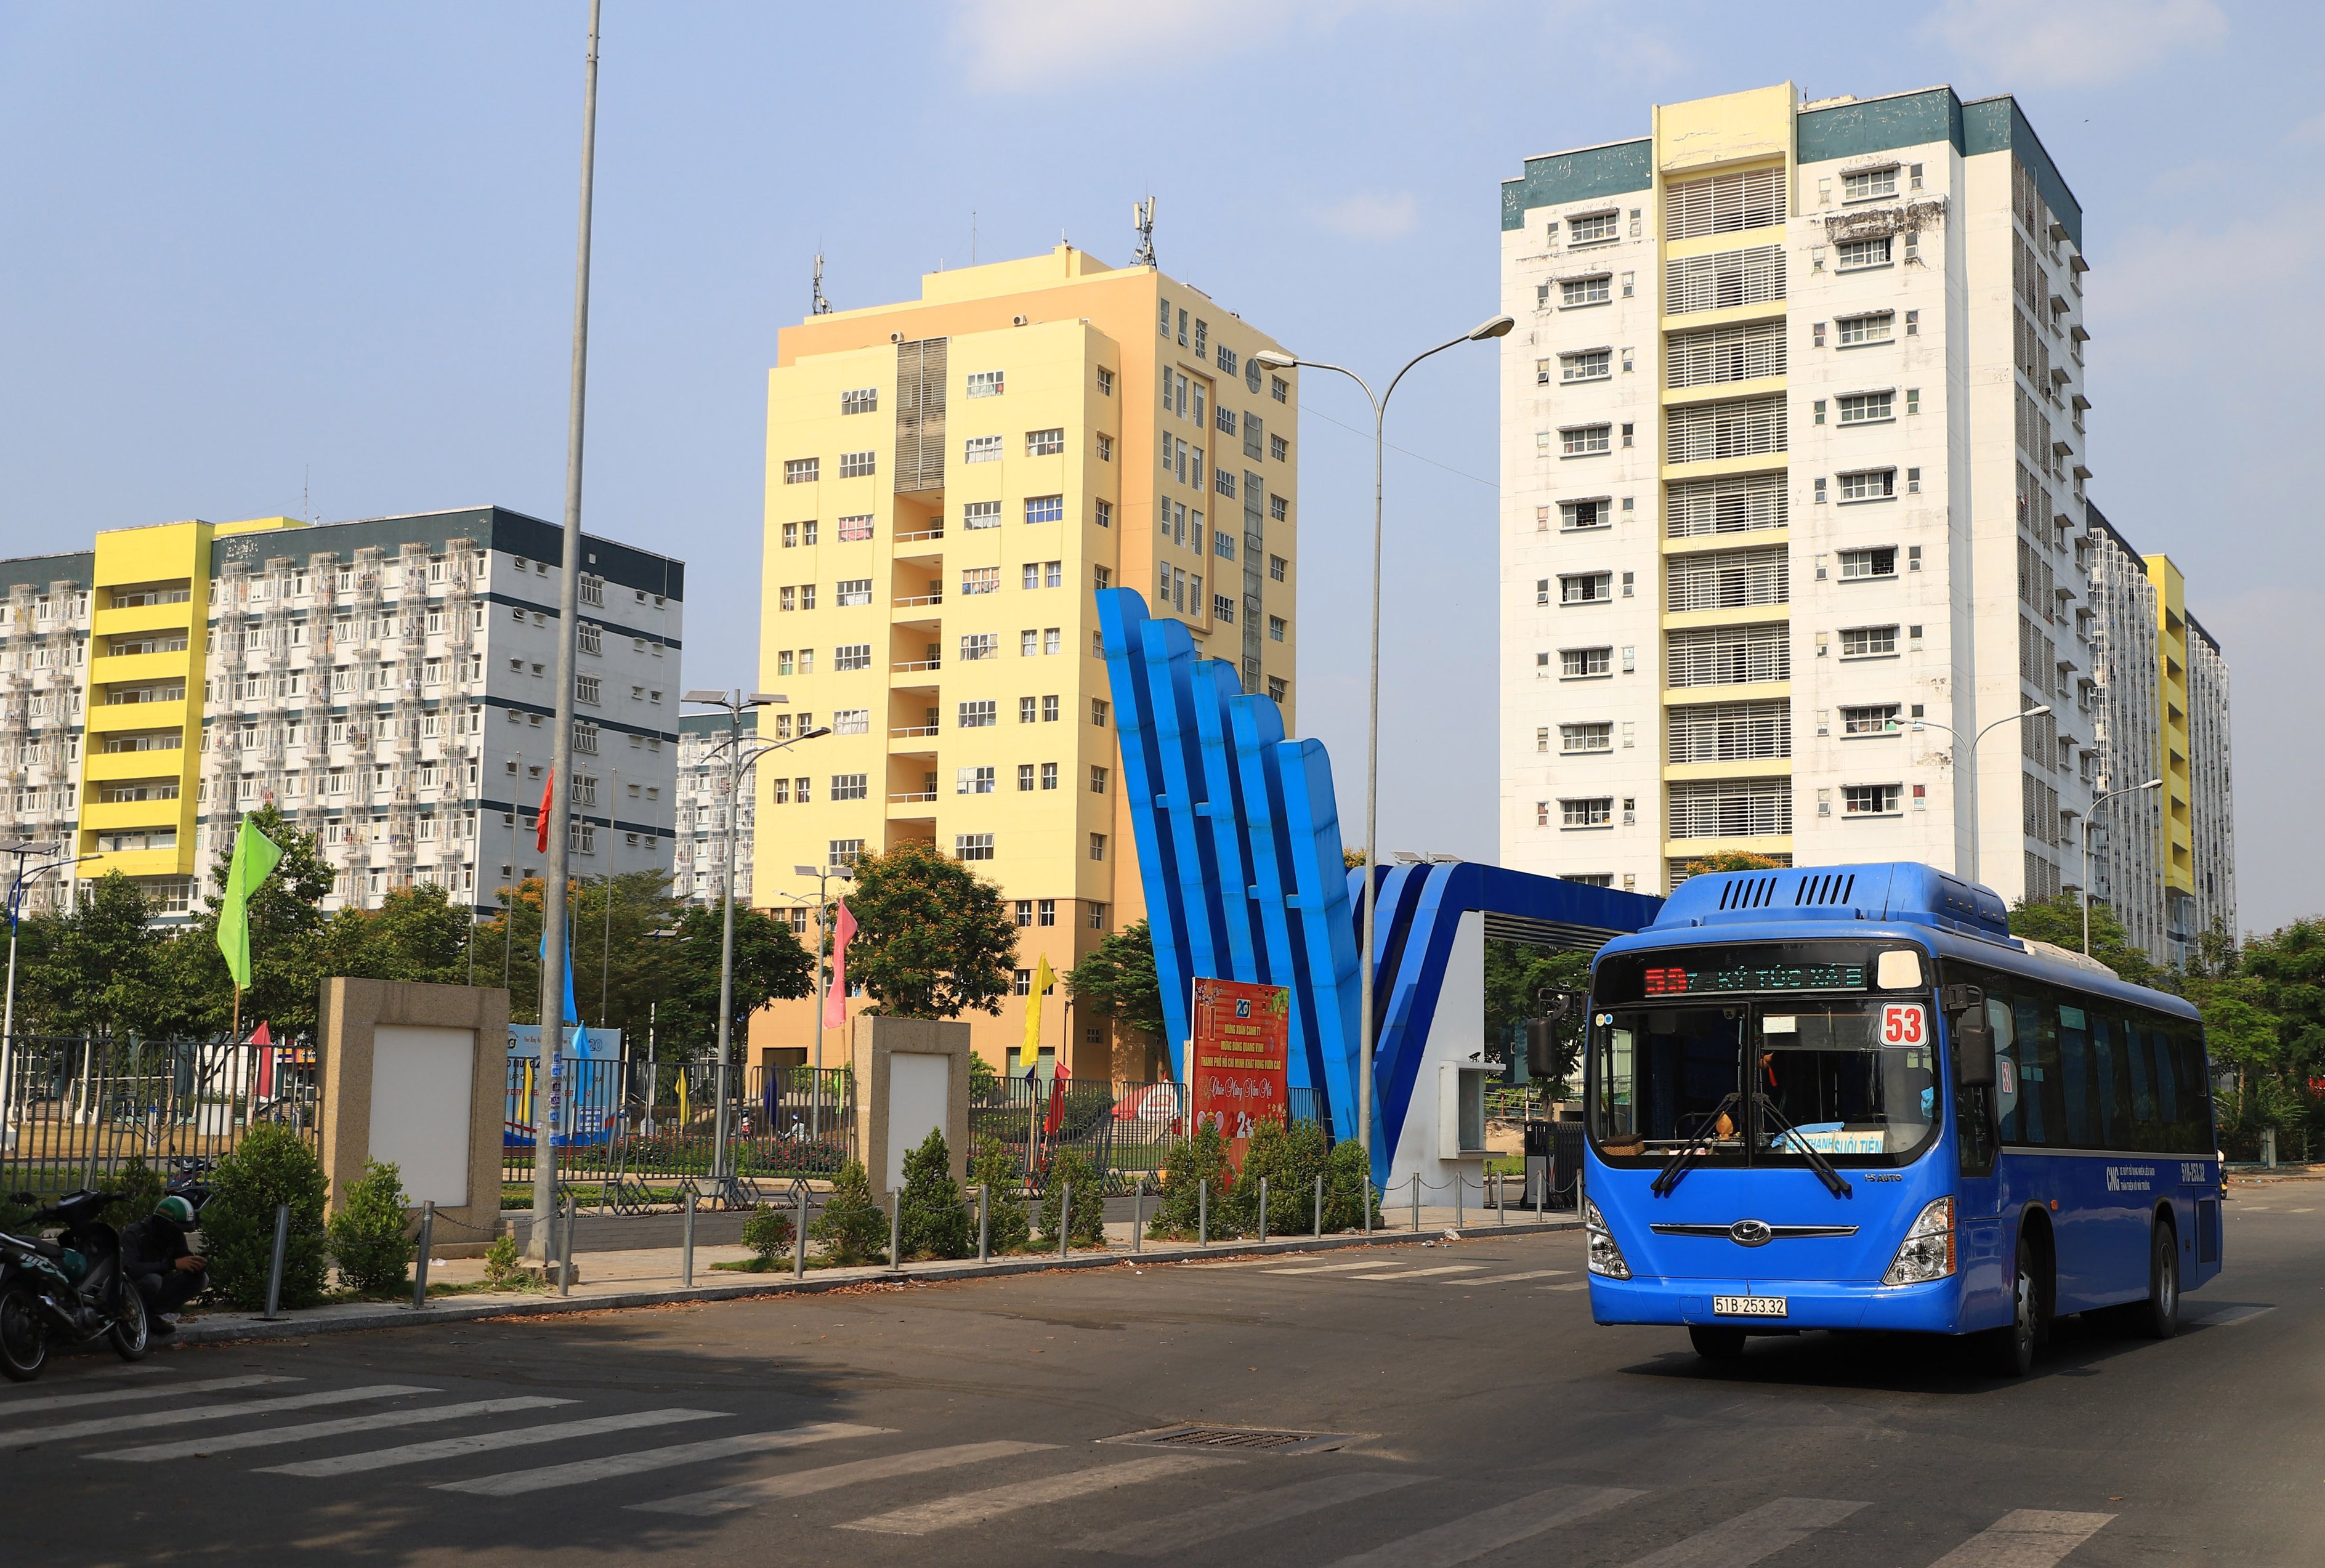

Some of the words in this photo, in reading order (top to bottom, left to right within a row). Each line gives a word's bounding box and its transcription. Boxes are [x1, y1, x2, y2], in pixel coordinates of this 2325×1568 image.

[1646, 969, 1686, 993] 53
[1886, 1008, 1921, 1043] 53
[1877, 1174, 1902, 1182] AUTO
[2106, 1166, 2120, 1192] CNG
[1716, 1298, 1784, 1313] 51B-253.32
